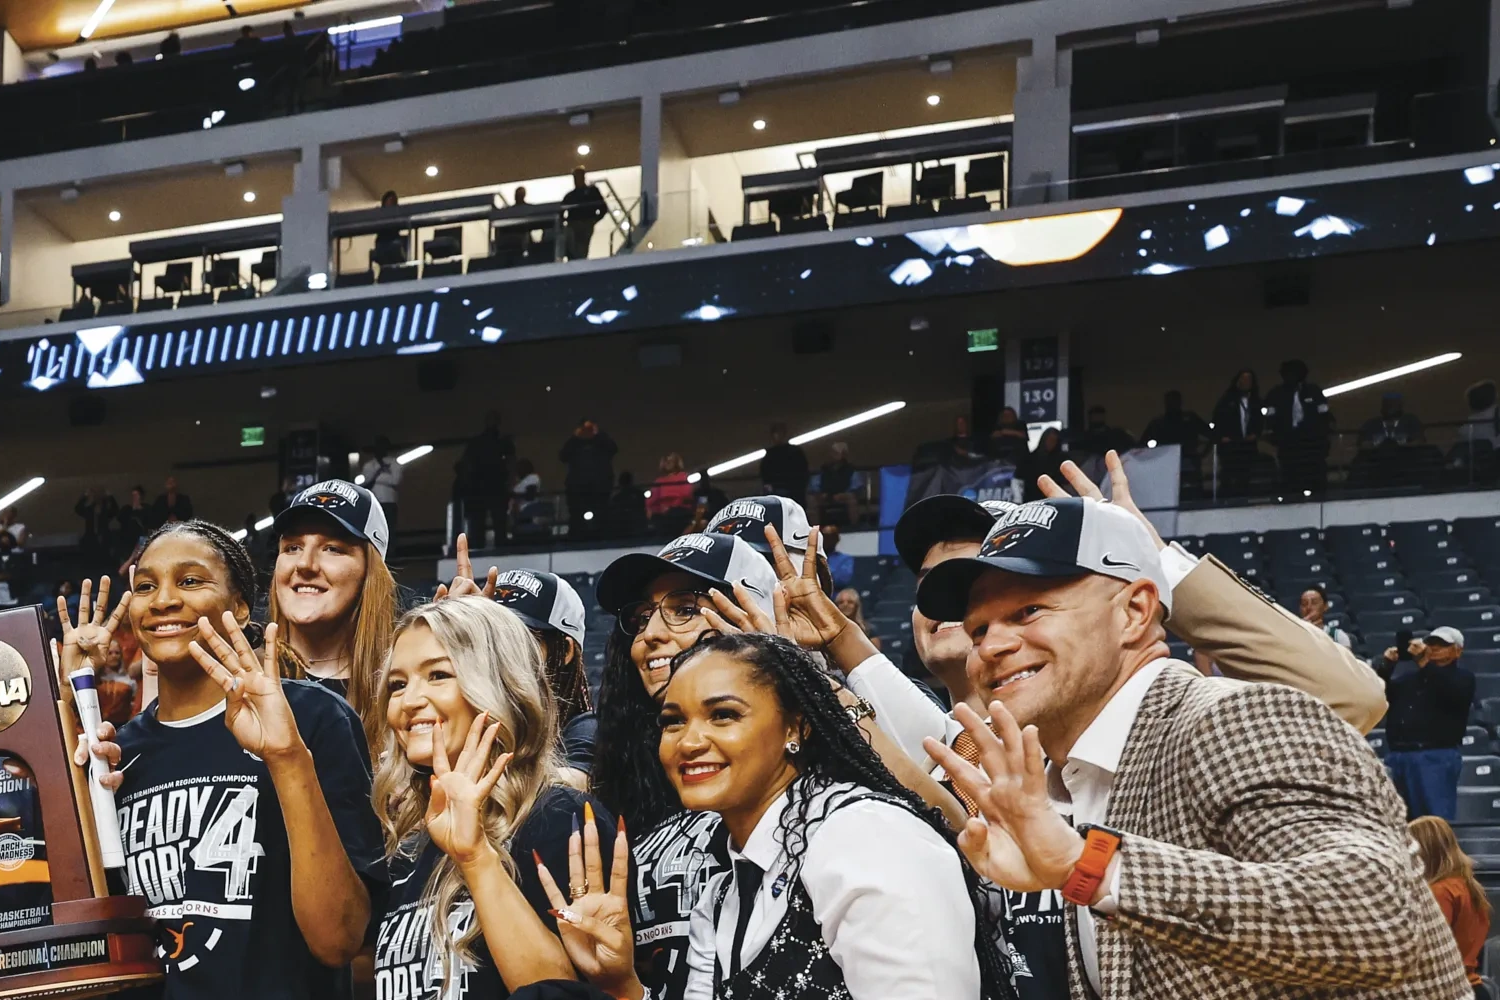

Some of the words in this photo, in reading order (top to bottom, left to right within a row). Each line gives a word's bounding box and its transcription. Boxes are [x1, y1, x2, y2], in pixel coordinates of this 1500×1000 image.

[1023, 388, 1055, 404] 130
[330, 482, 358, 506] FOUR
[731, 504, 765, 521] FOUR
[1008, 505, 1056, 529] FOUR
[676, 534, 713, 553] FOUR
[511, 573, 542, 596] FOUR
[134, 781, 174, 799] BIRMINGHAM
[175, 776, 210, 788] REGIONAL
[211, 775, 258, 783] CHAMPIONS
[117, 785, 214, 856] READY
[189, 784, 266, 902] 4
[50, 940, 105, 962] CHAMPION
